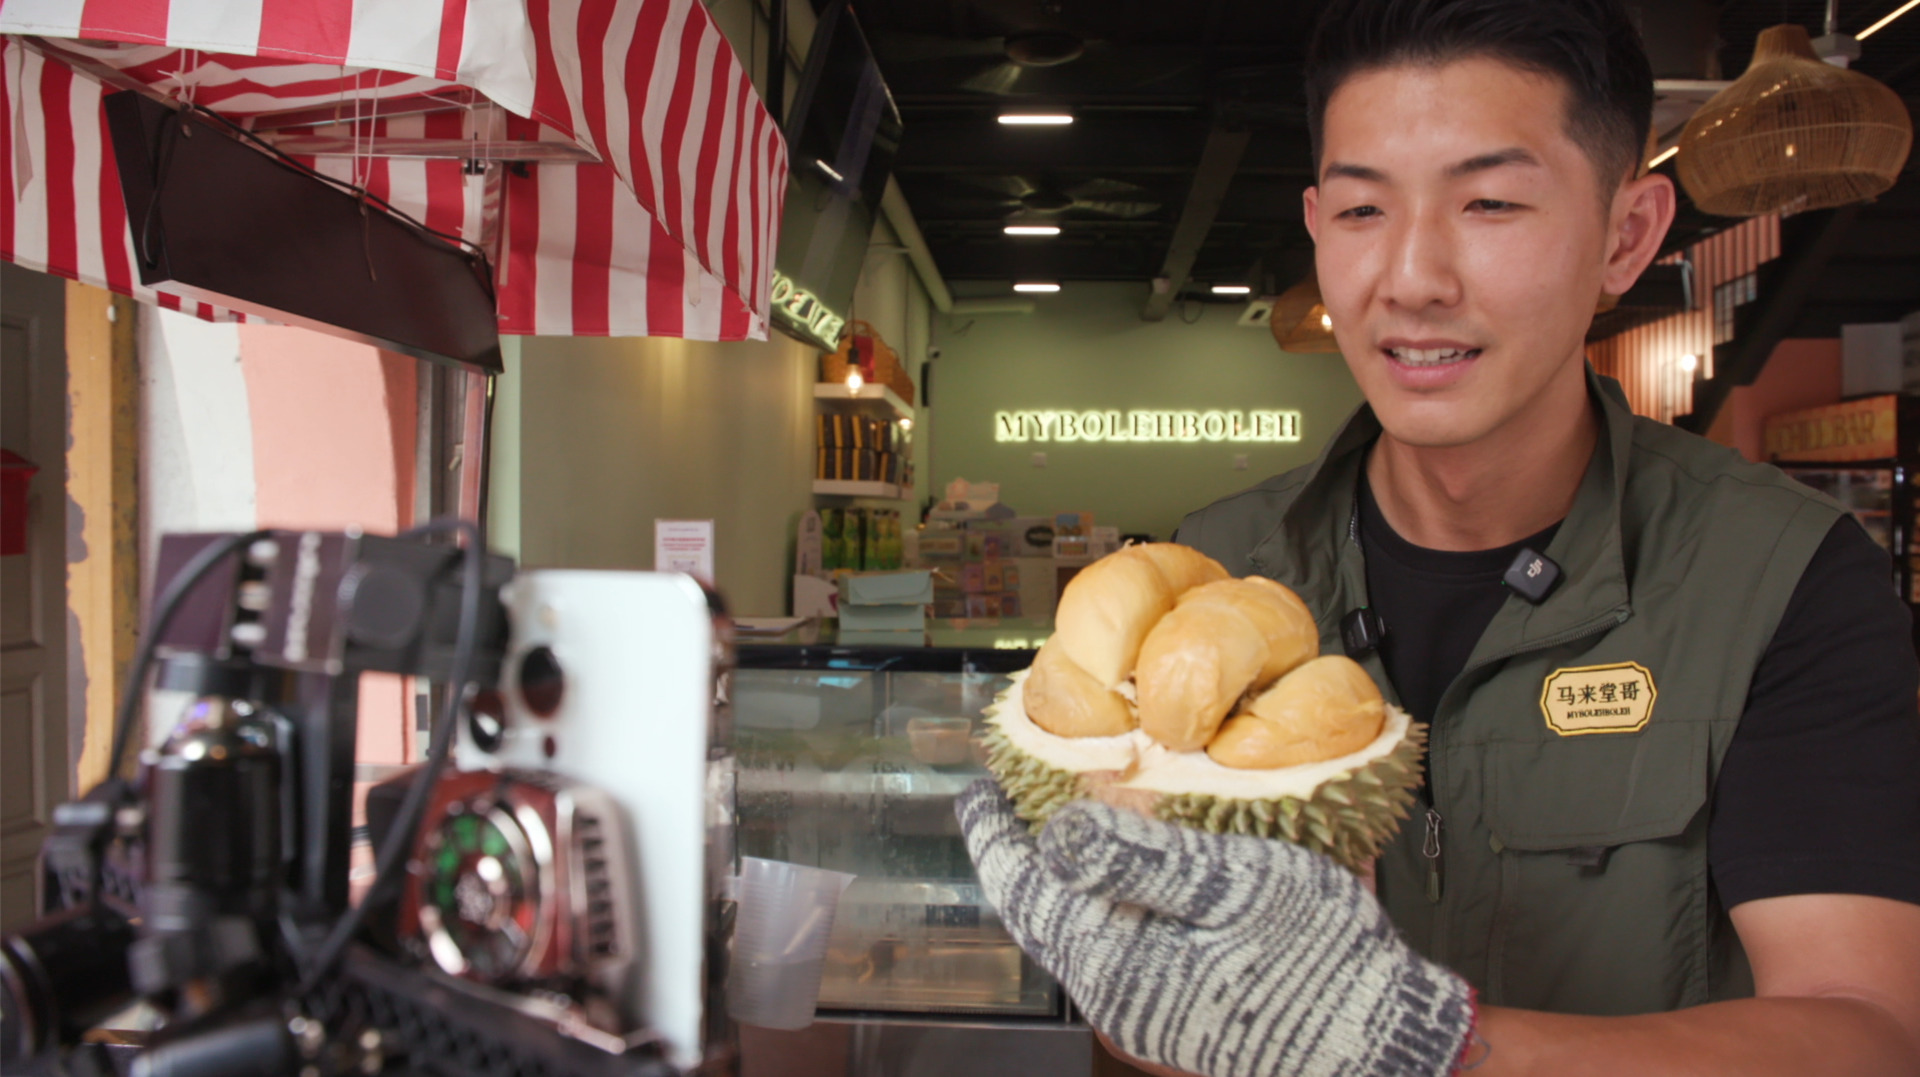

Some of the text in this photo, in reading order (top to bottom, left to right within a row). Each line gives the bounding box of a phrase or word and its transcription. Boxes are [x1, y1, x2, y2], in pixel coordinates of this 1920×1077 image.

[995, 410, 1301, 442] MYBOLEHBOLEH
[1556, 680, 1640, 706] 马来堂哥
